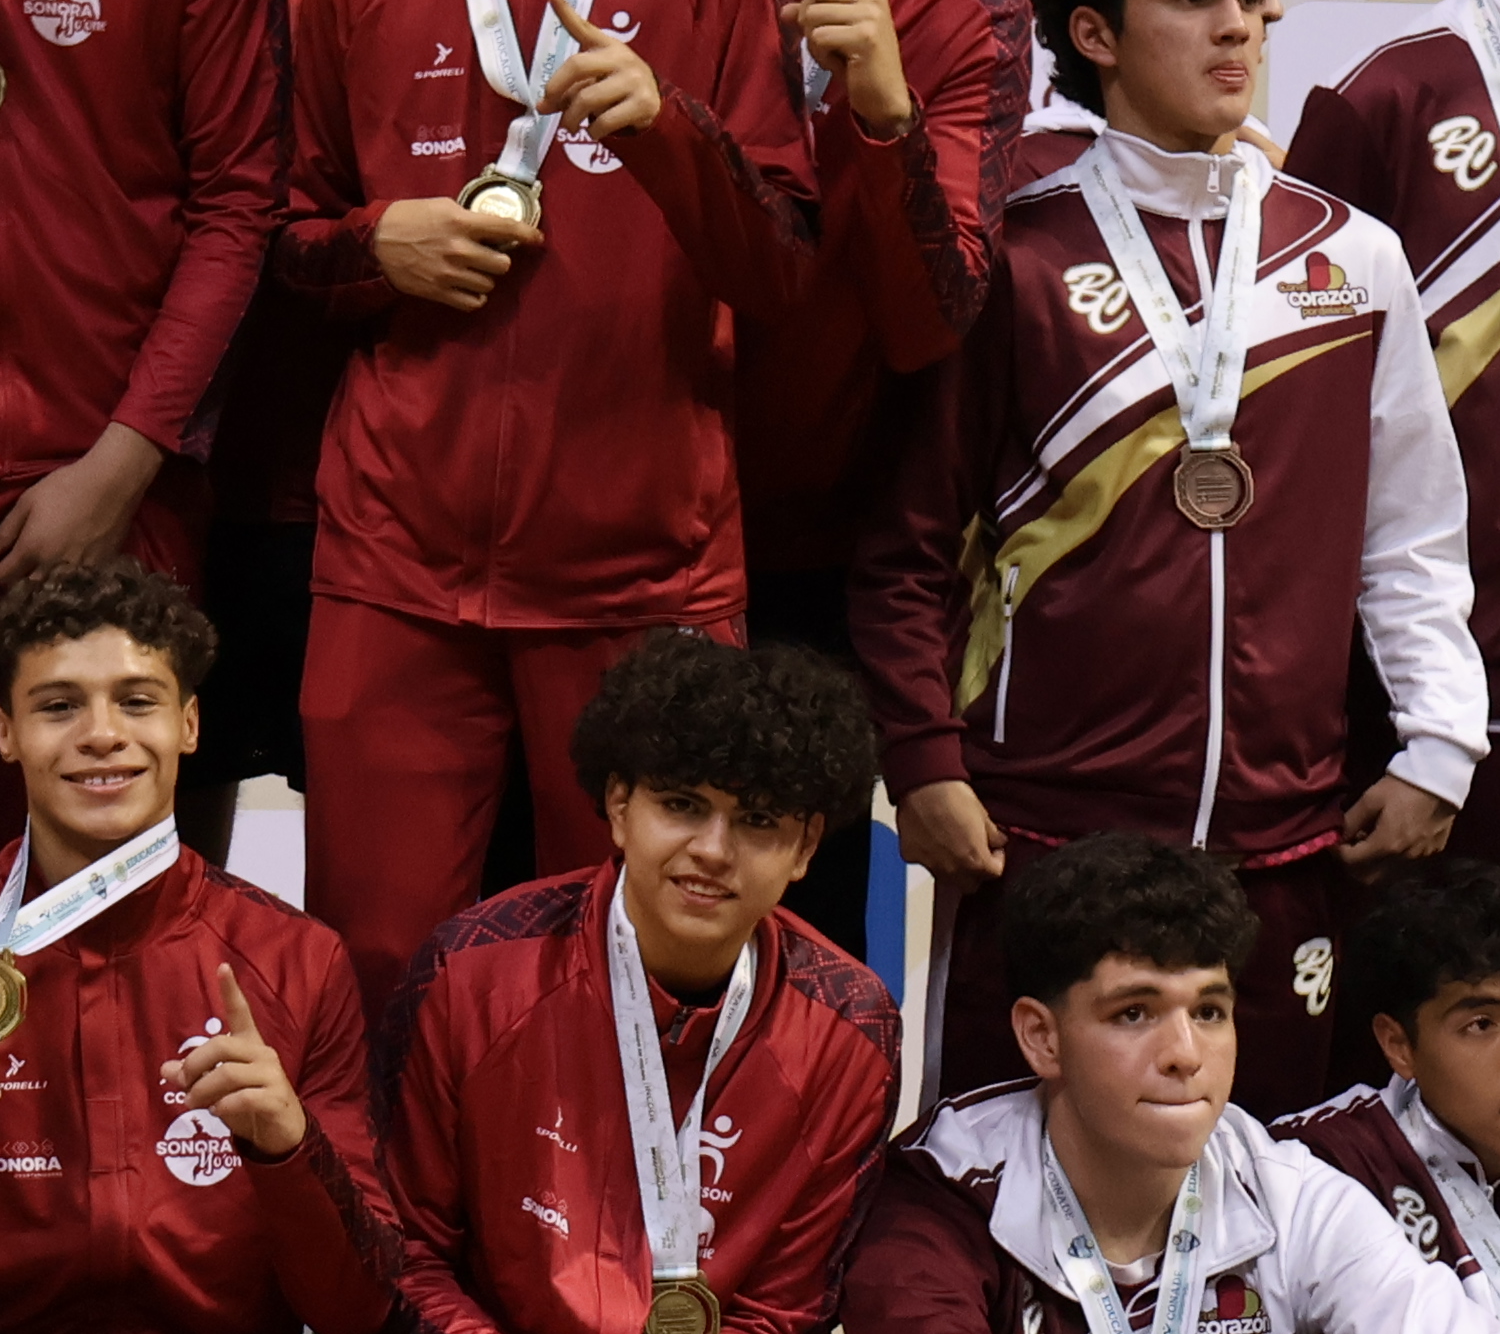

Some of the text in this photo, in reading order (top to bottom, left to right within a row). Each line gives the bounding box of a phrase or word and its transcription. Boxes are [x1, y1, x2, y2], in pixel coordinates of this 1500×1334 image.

[1427, 113, 1499, 193] BC
[1061, 262, 1133, 336] BC
[1286, 283, 1369, 314] corazón
[124, 834, 169, 871] EDUCACIÓN
[156, 1140, 233, 1164] SONORA
[1049, 1178, 1072, 1221] CONADE
[1166, 1269, 1184, 1325] CONADE
